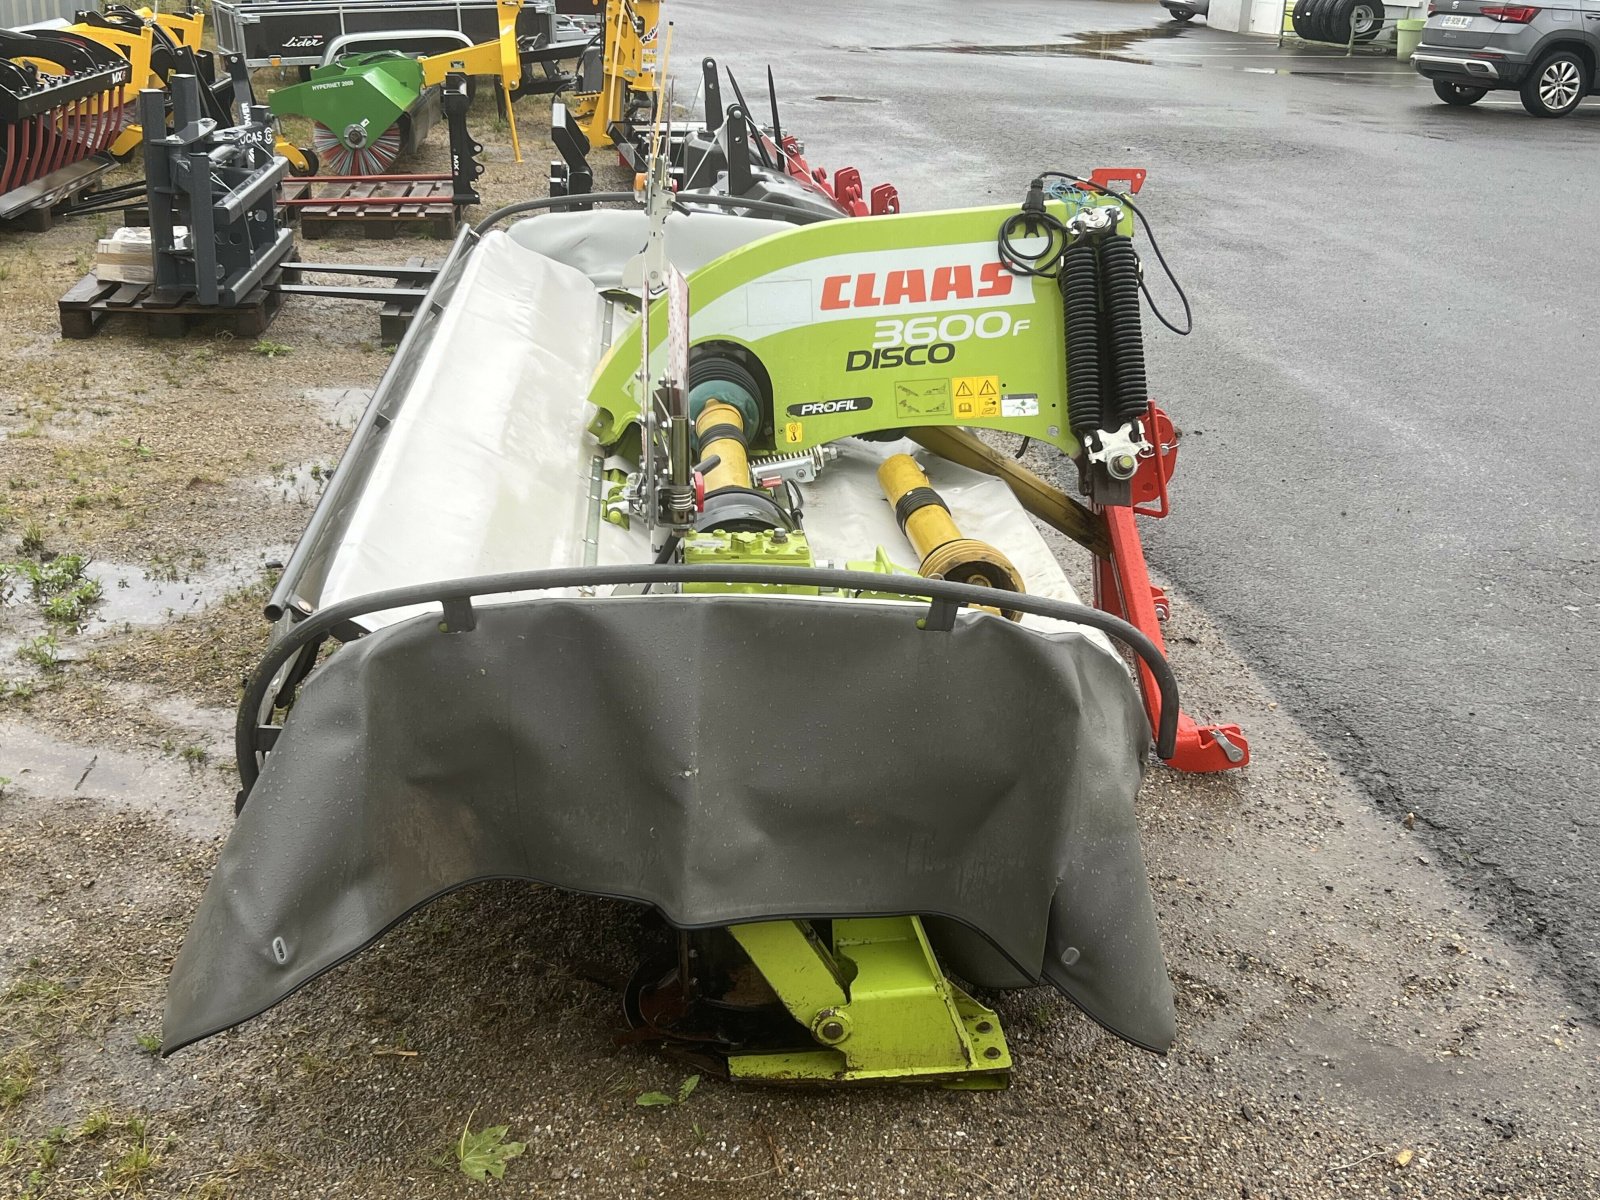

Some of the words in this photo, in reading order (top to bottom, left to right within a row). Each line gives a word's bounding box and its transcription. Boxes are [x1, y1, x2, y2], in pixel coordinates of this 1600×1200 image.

[282, 36, 324, 48] Lider
[238, 131, 262, 145] UCAS
[820, 260, 1014, 311] CLAAS
[845, 343, 956, 373] DISCO
[800, 398, 859, 416] PROFIL
